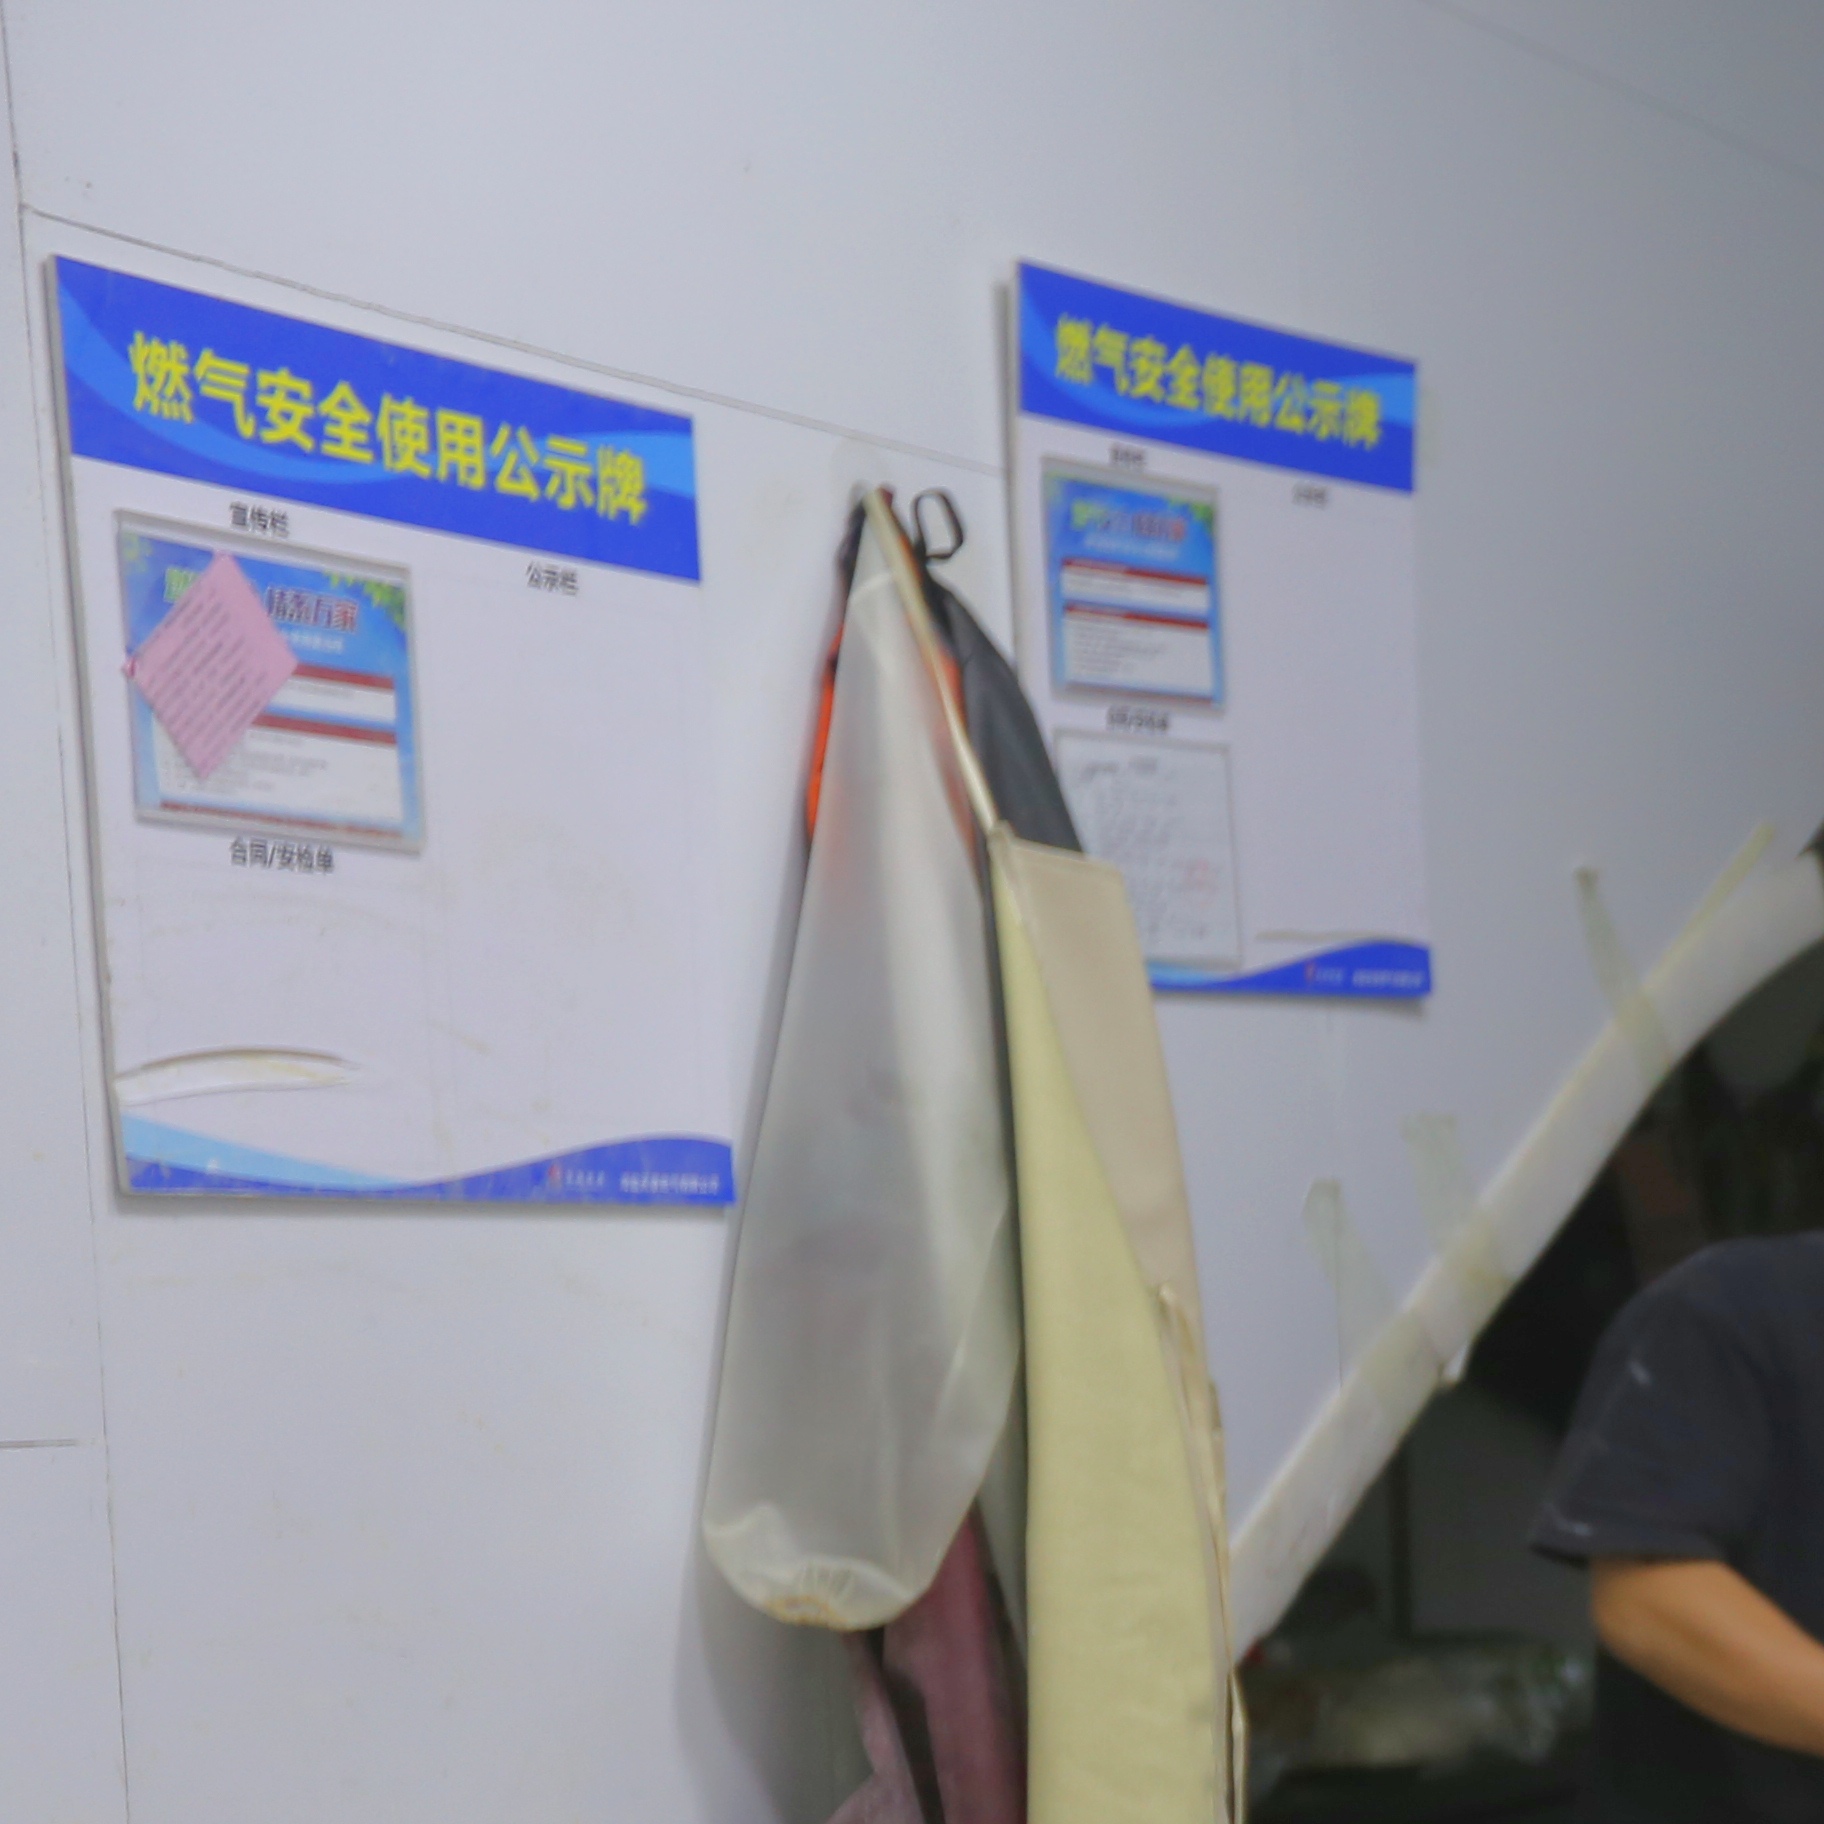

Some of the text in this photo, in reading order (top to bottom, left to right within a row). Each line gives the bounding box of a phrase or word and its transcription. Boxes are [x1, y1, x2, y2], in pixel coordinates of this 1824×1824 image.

[128, 331, 652, 525] 燃气安全使用公示牌
[229, 501, 290, 538] 宣传栏
[525, 560, 580, 597] 公示栏
[229, 836, 336, 876] 合同/安检单
